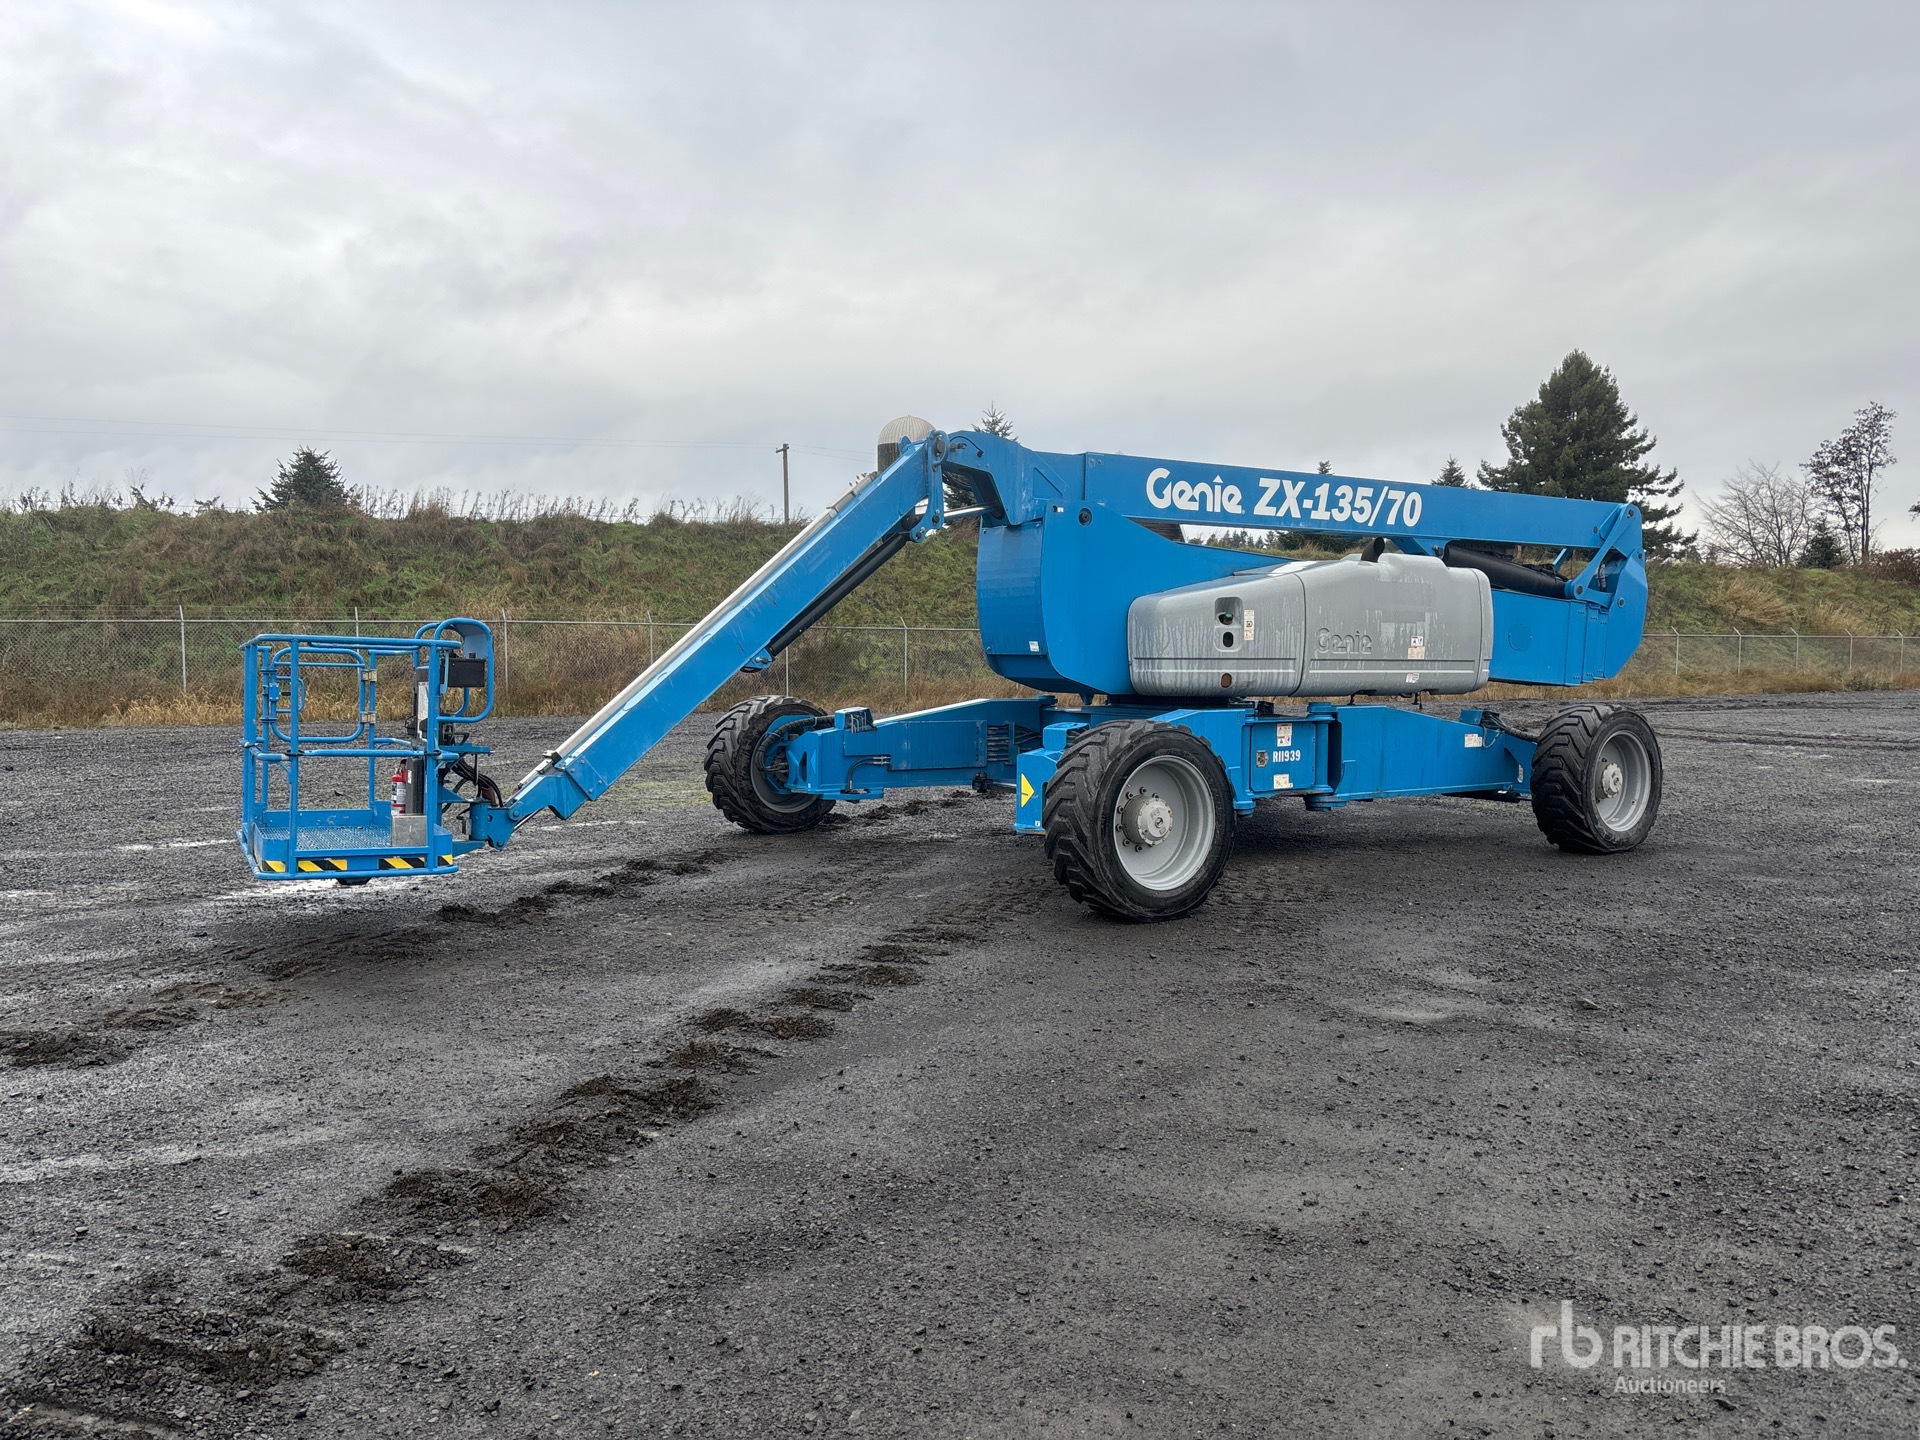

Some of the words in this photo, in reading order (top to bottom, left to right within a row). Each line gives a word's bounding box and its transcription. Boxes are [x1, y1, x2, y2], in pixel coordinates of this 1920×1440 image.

[1146, 467, 1243, 514] Genie
[1253, 477, 1423, 527] ZX-135/70
[1317, 627, 1372, 654] Genie
